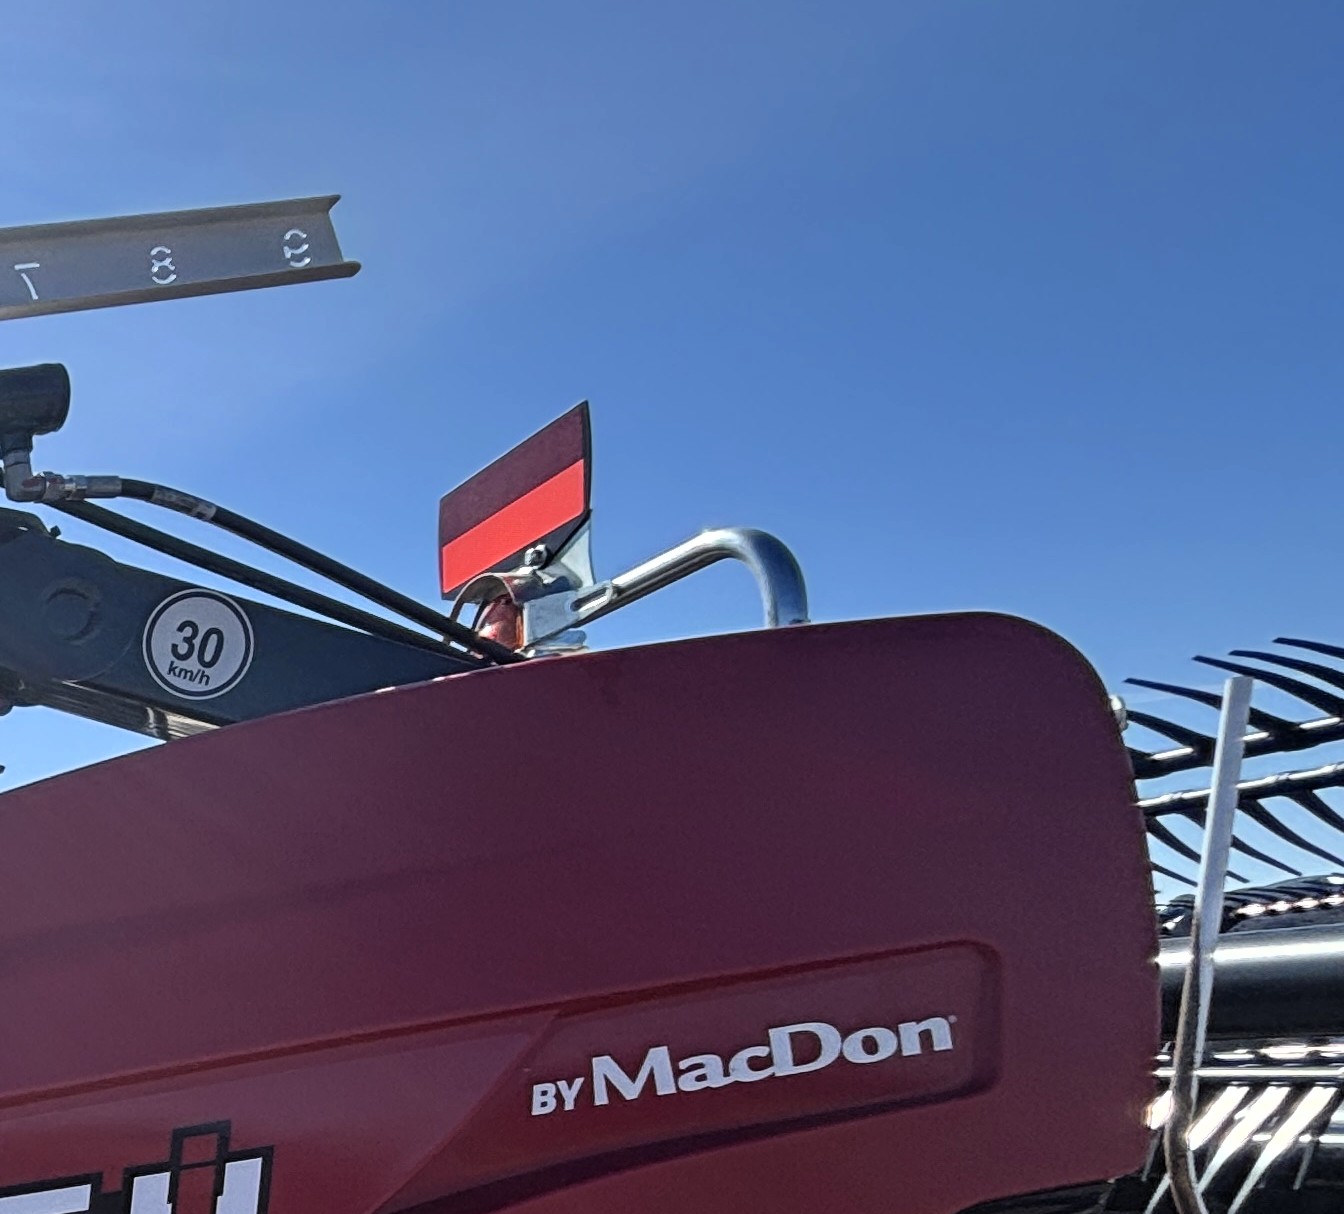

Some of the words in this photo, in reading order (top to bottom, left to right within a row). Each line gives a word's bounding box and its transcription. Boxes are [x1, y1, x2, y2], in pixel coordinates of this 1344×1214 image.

[171, 620, 224, 669] 30
[167, 660, 211, 686] km/h
[531, 1077, 584, 1116] BY
[592, 1016, 954, 1106] MacDon
